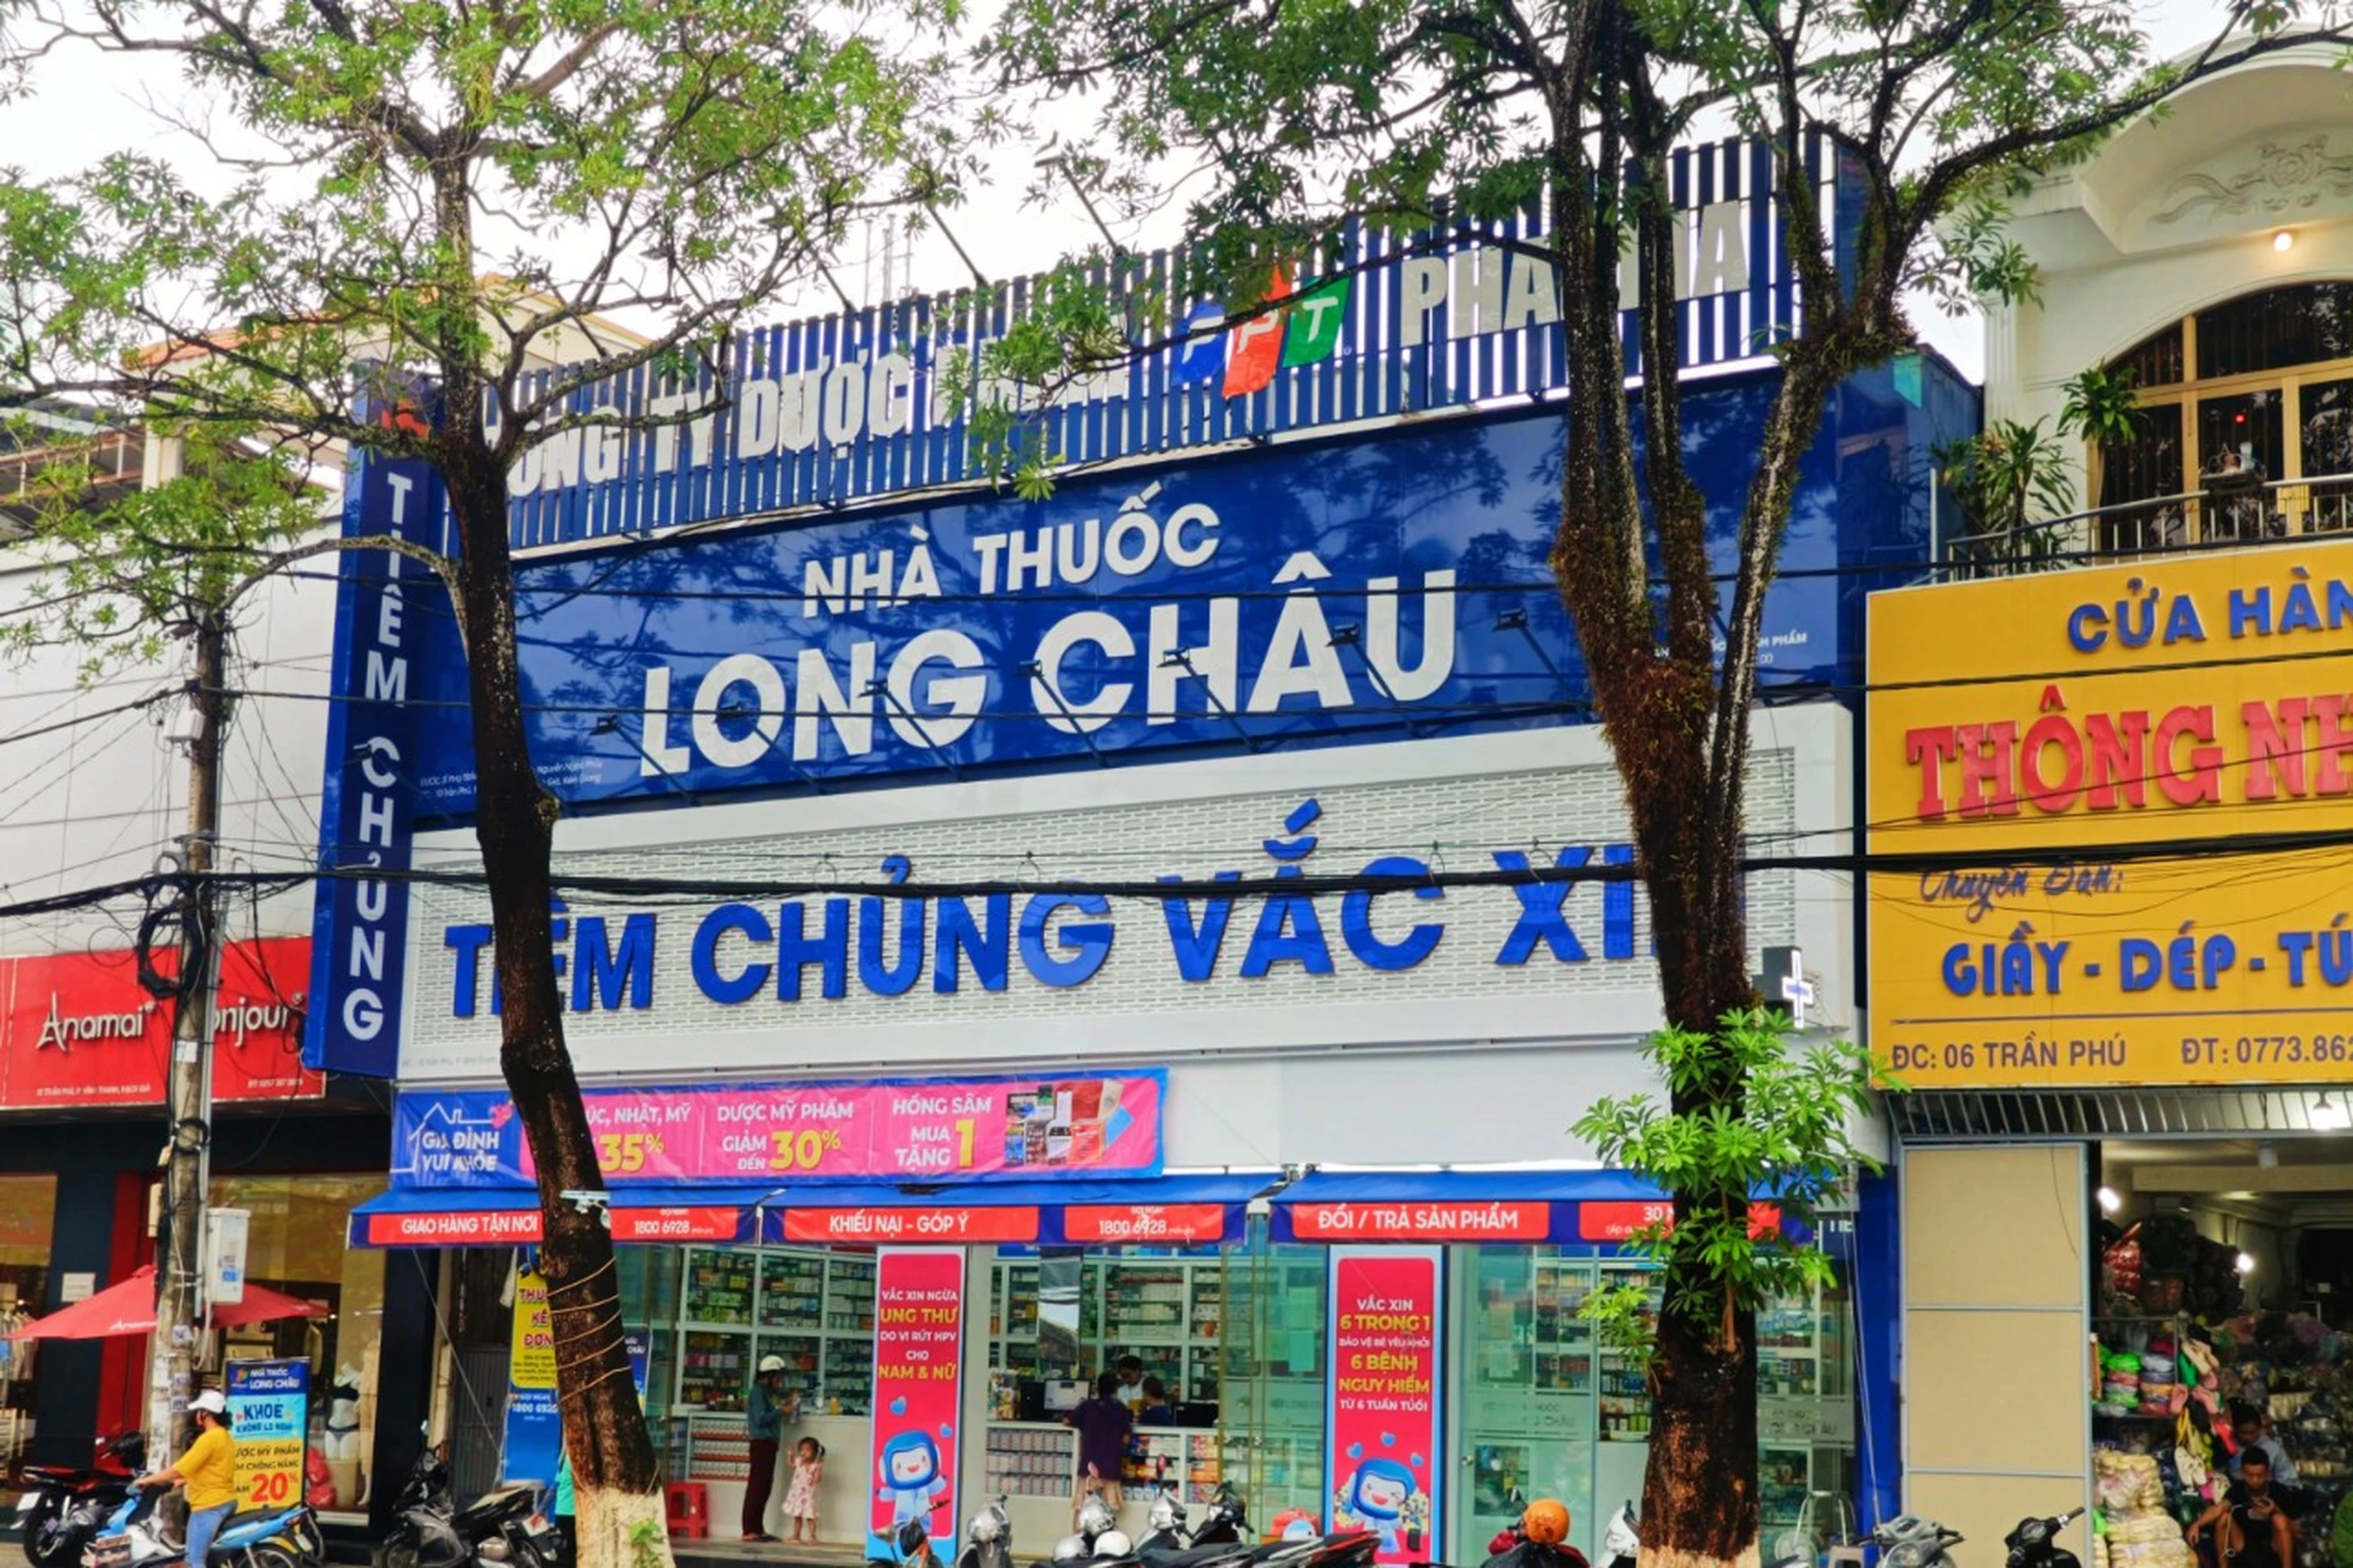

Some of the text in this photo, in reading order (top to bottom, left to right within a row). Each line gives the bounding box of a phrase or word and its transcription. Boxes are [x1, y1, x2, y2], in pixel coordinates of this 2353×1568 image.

[651, 388, 715, 474] TY
[738, 348, 909, 459] DƯỢC
[803, 480, 1221, 619] NHÀ THUỐC
[2068, 577, 2206, 653] CỬA
[641, 552, 1456, 777] LONG CHÂU
[343, 472, 412, 1040] TIÊM CHỦNG
[691, 855, 1115, 1004] CHỦNG
[1156, 797, 1445, 982] VẮC
[1491, 844, 1654, 964] XI
[2120, 920, 2236, 993] DÉP
[2279, 912, 2353, 988] TÚ
[1892, 1045, 1937, 1070] ĐC:
[1944, 1044, 1975, 1068] 06
[1984, 1030, 2058, 1068] TRẦN
[2070, 1032, 2126, 1066] PHÚ
[2182, 1038, 2228, 1065] ĐT:
[614, 1102, 663, 1127] NHẬT,
[665, 1102, 691, 1122] MỸ
[717, 1096, 854, 1125] DƯỢC MỸ PHẨM
[951, 1093, 992, 1114] SÂM
[452, 1126, 500, 1150] ĐÌNH
[722, 1129, 767, 1152] GIẢM
[911, 1126, 950, 1142] MUA
[956, 1119, 975, 1167] 1
[599, 1133, 665, 1172] 35%
[737, 1153, 766, 1170] ĐẾN
[769, 1130, 841, 1170] 30%
[894, 1144, 950, 1171] TẶNG
[402, 1212, 538, 1237] GIAO HÀNG TẬN NƠI
[829, 1209, 872, 1233] KHIẾU
[875, 1215, 903, 1238] NẠI
[916, 1210, 954, 1233] GÓP
[958, 1210, 969, 1233] Ý
[1373, 1206, 1410, 1228] TRẢ
[1415, 1206, 1457, 1228] SẢN
[1461, 1202, 1518, 1228] PHẨM
[1643, 1206, 1663, 1221] 30
[634, 1221, 659, 1234] 1800
[1099, 1220, 1130, 1235] 1800
[518, 1289, 547, 1301] THU
[882, 1287, 904, 1301] VẮC
[906, 1290, 925, 1301] XIN
[1358, 1294, 1413, 1311] VẮC XIN
[881, 1306, 959, 1324] UNG THƯ
[1340, 1314, 1431, 1331] 6 TRONG 1
[880, 1329, 956, 1341] DO VI RÚT HPV
[905, 1350, 929, 1360] CHO
[1351, 1350, 1418, 1374] 6 BỆNH
[879, 1362, 957, 1380] NAM & NỮ
[1338, 1373, 1429, 1393] NGUY HIỂM
[249, 1380, 273, 1390] LONG
[275, 1377, 301, 1389] CHÂU
